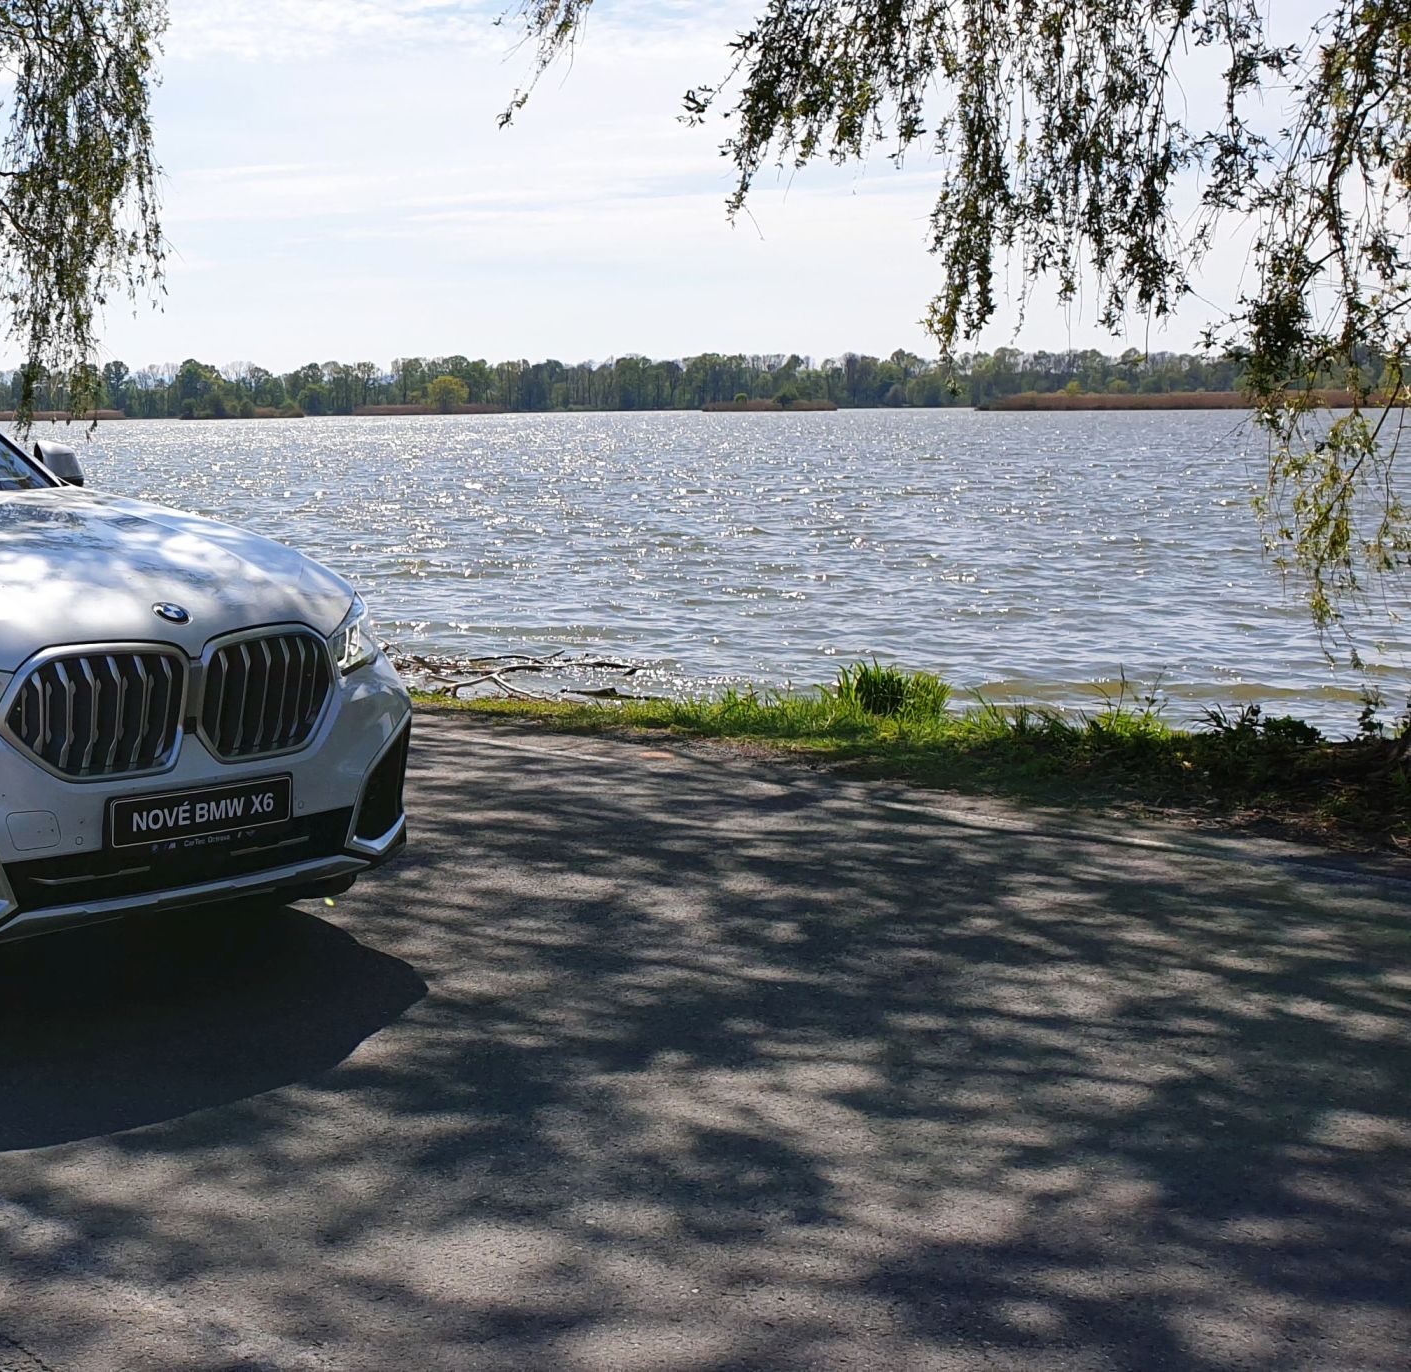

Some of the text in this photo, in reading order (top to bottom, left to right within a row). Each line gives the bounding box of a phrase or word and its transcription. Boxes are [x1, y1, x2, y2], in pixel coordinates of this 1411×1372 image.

[132, 792, 275, 832] NOVÉ BMW X6
